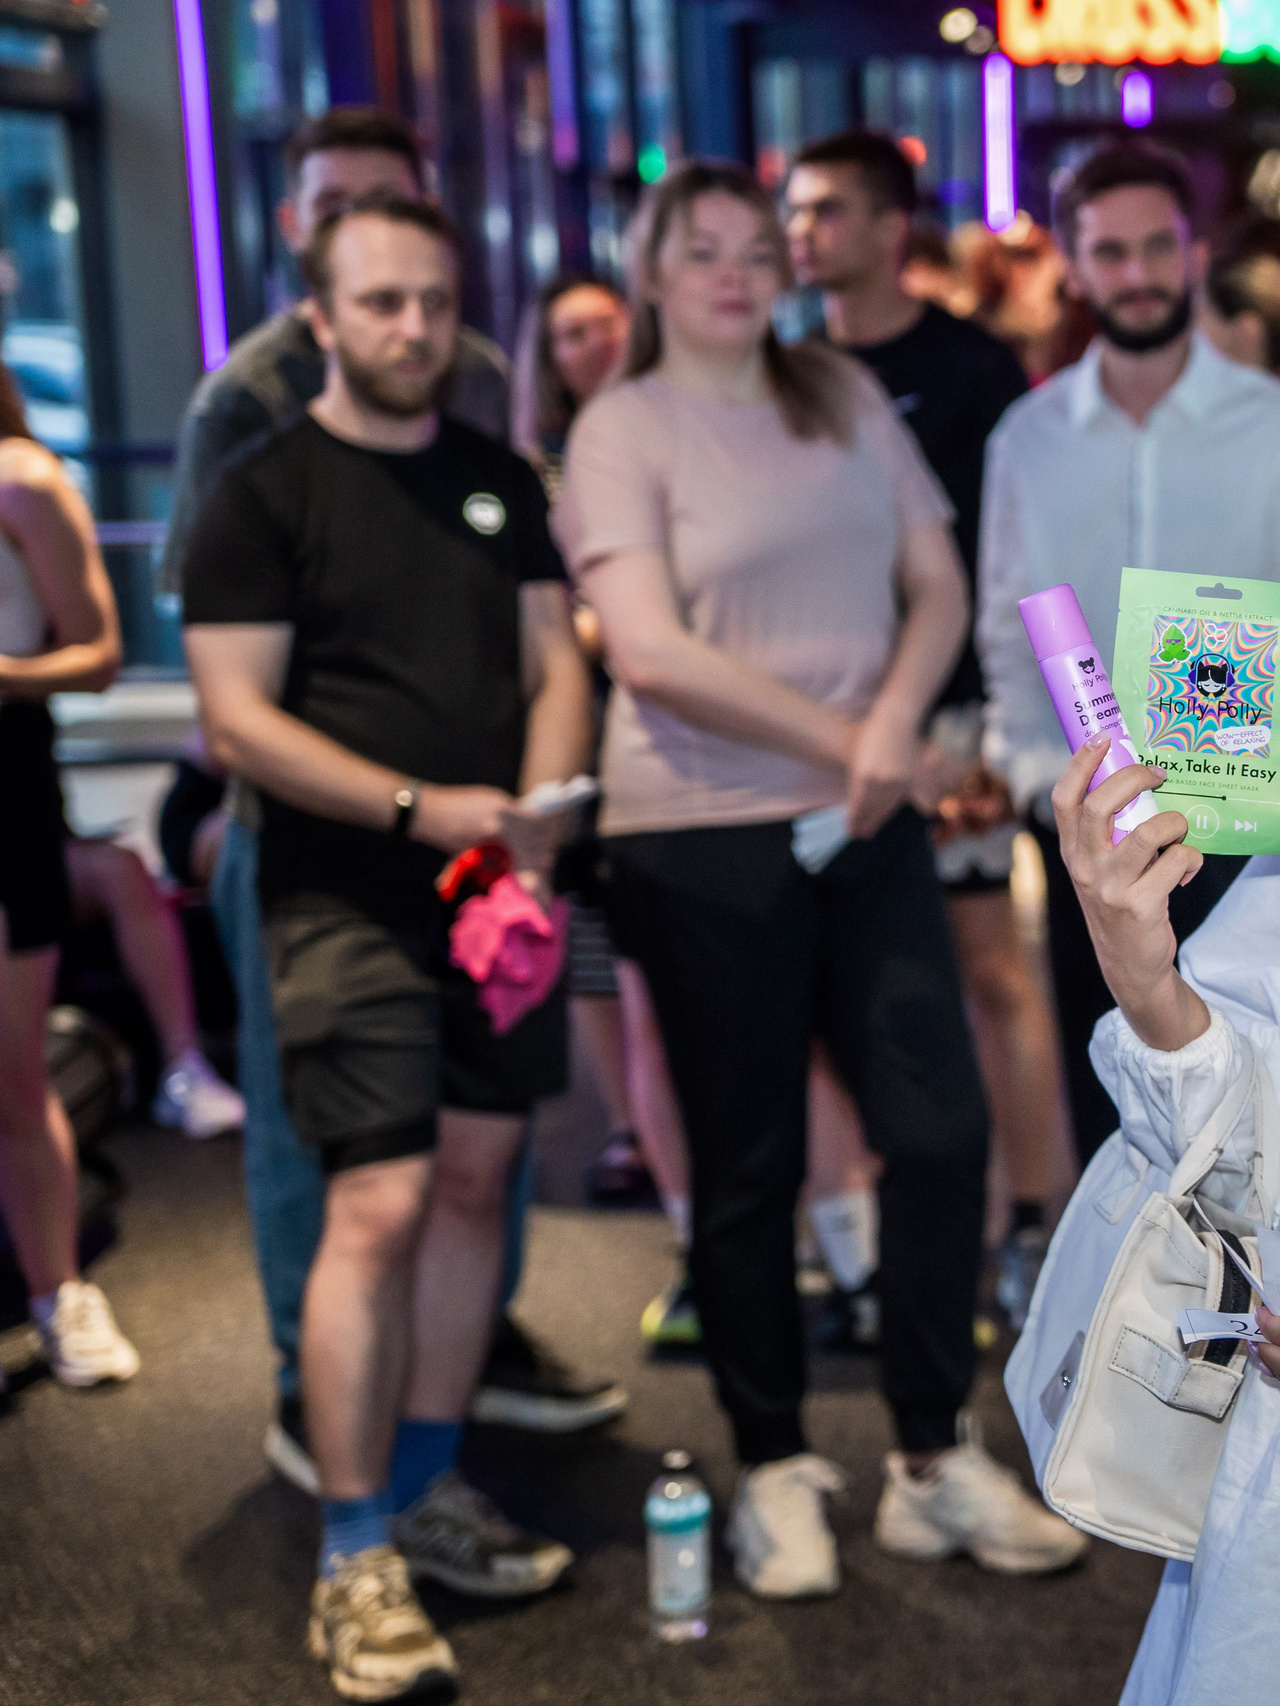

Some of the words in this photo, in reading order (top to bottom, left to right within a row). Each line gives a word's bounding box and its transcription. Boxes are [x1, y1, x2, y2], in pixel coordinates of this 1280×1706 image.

[1162, 606, 1198, 615] CANNABIS
[1199, 609, 1211, 617] OIL
[1219, 611, 1242, 620] NETTLE
[1244, 613, 1273, 622] EXTRACT
[1159, 696, 1209, 721] Holly
[1217, 700, 1262, 725] Polly
[1232, 736, 1266, 746] RELAXING
[1185, 758, 1221, 775] Take
[1226, 762, 1237, 776] It
[1240, 763, 1277, 784] Easy
[1218, 782, 1238, 790] SHEET
[1230, 1319, 1263, 1337] 2
